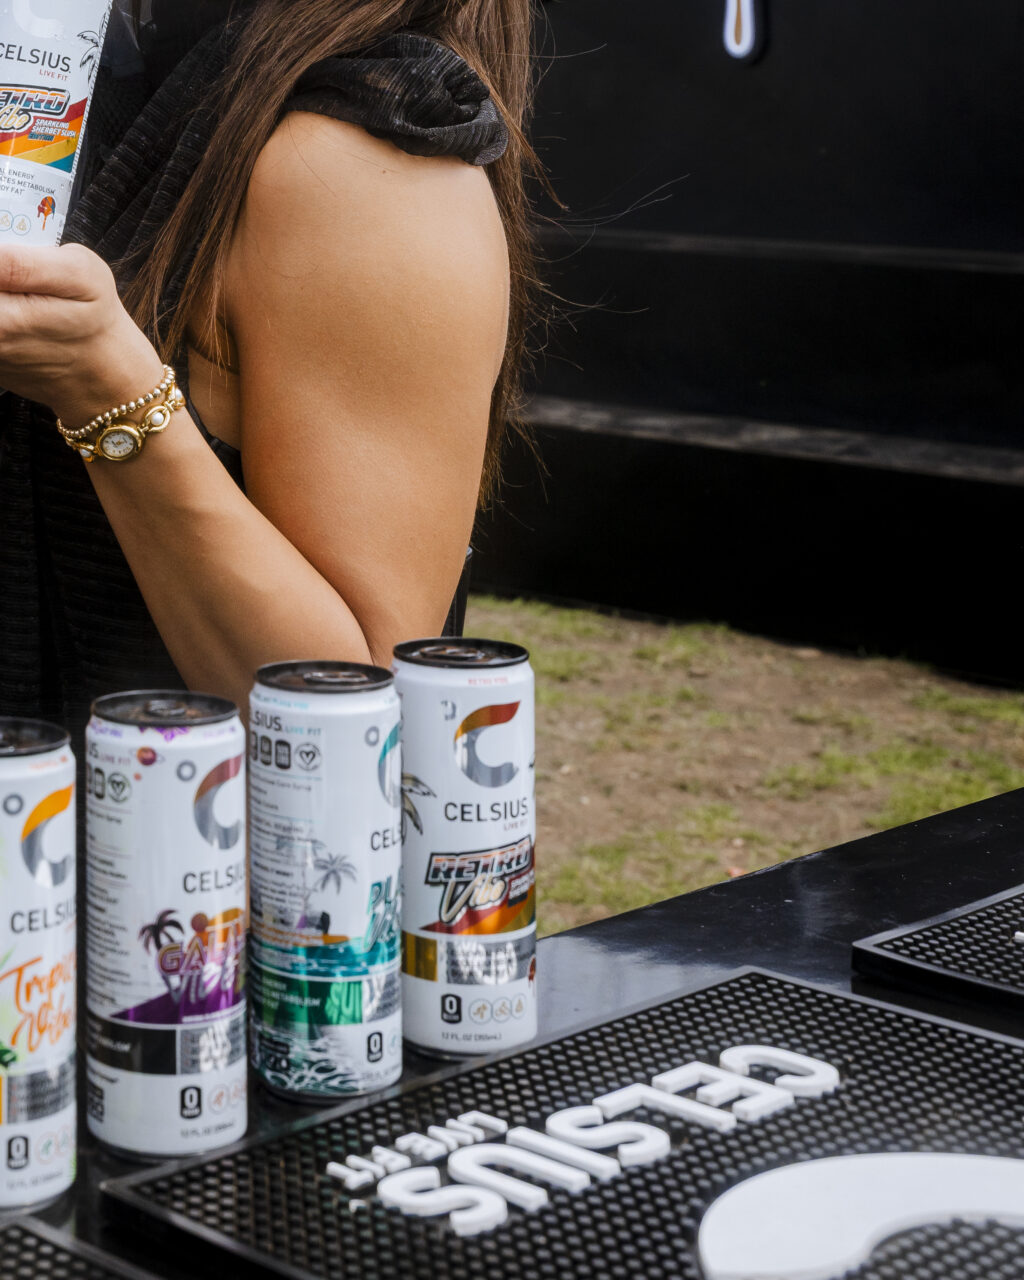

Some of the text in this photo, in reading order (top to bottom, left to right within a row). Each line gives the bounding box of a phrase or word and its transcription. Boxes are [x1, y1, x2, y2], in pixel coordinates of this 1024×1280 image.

[39, 69, 55, 78] LIVE
[35, 119, 70, 130] SPARKLING
[31, 126, 61, 136] SHERBET
[8, 170, 35, 180] ENERGY
[10, 187, 24, 195] FAT
[17, 180, 56, 194] METABOLISM
[444, 797, 528, 822] CELSIUS
[376, 1043, 841, 1238] CELSIUS
